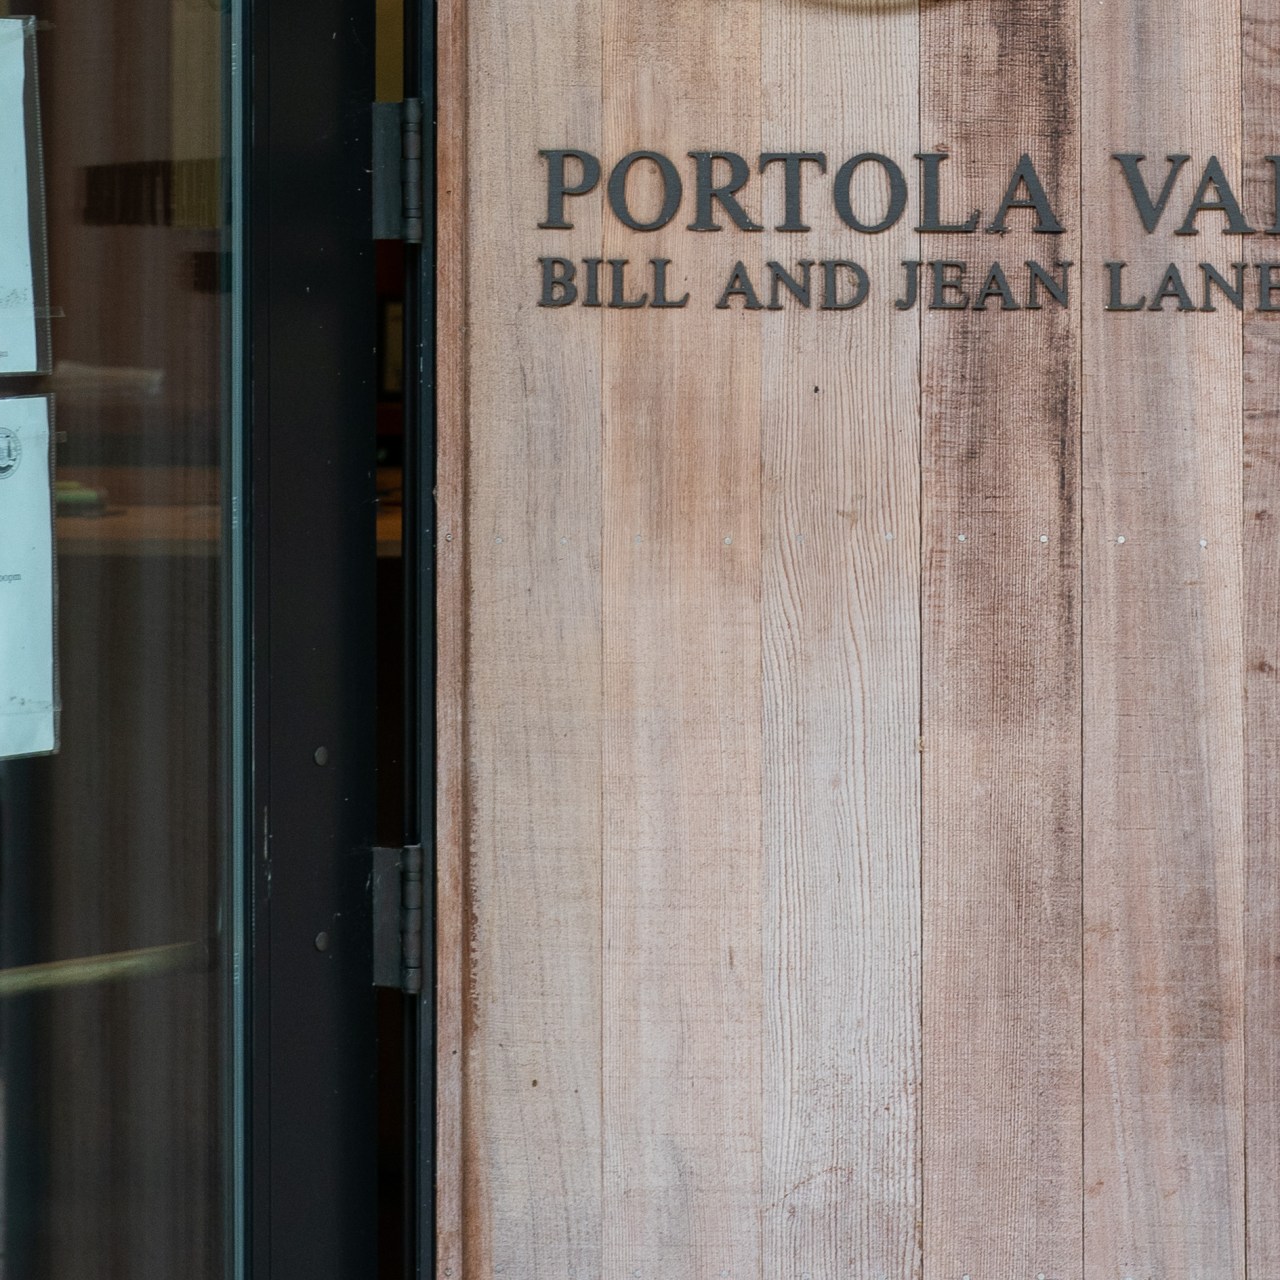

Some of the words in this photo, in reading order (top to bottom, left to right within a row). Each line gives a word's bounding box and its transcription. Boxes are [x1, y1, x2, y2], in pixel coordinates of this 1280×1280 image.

[536, 148, 1066, 236] PORTOLA
[536, 255, 690, 310] BILL
[715, 258, 872, 312] AND
[893, 259, 1076, 313] JEAN
